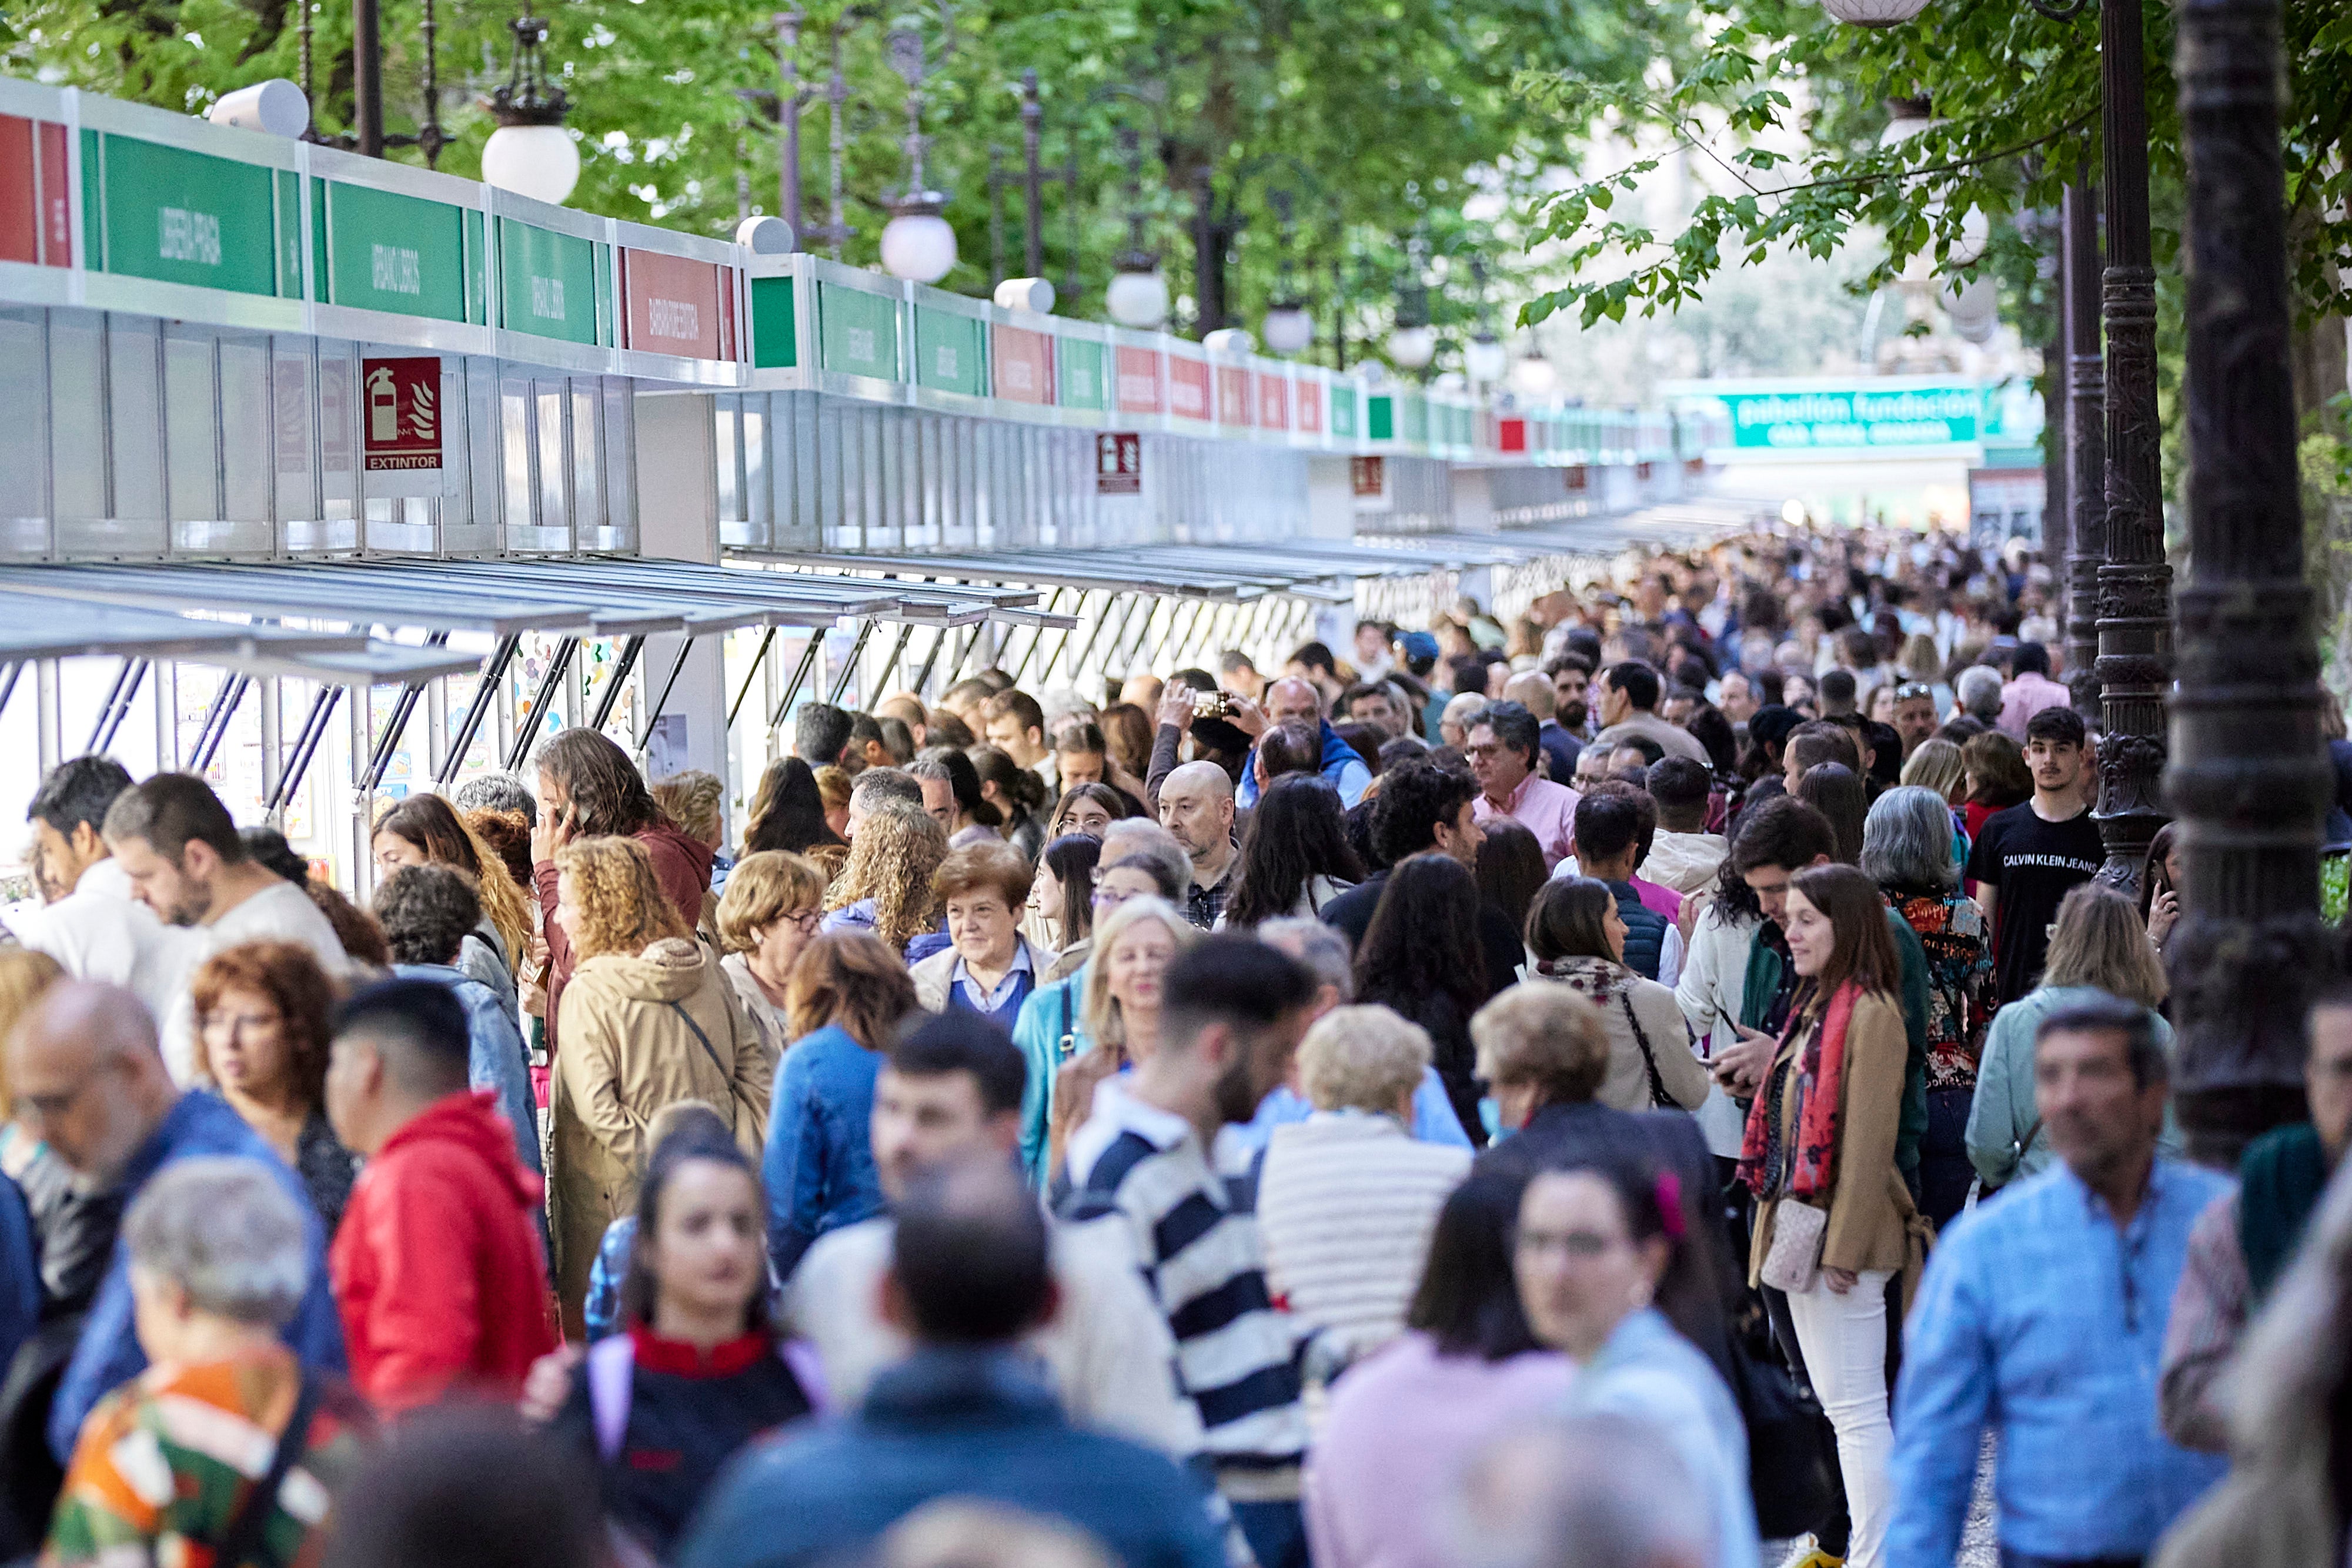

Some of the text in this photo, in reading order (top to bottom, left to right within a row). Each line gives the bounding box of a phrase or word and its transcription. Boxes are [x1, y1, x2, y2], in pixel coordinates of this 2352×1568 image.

[370, 456, 437, 469] EXTINTOR
[2003, 853, 2097, 874] CALVIN KLEIN JEANS
